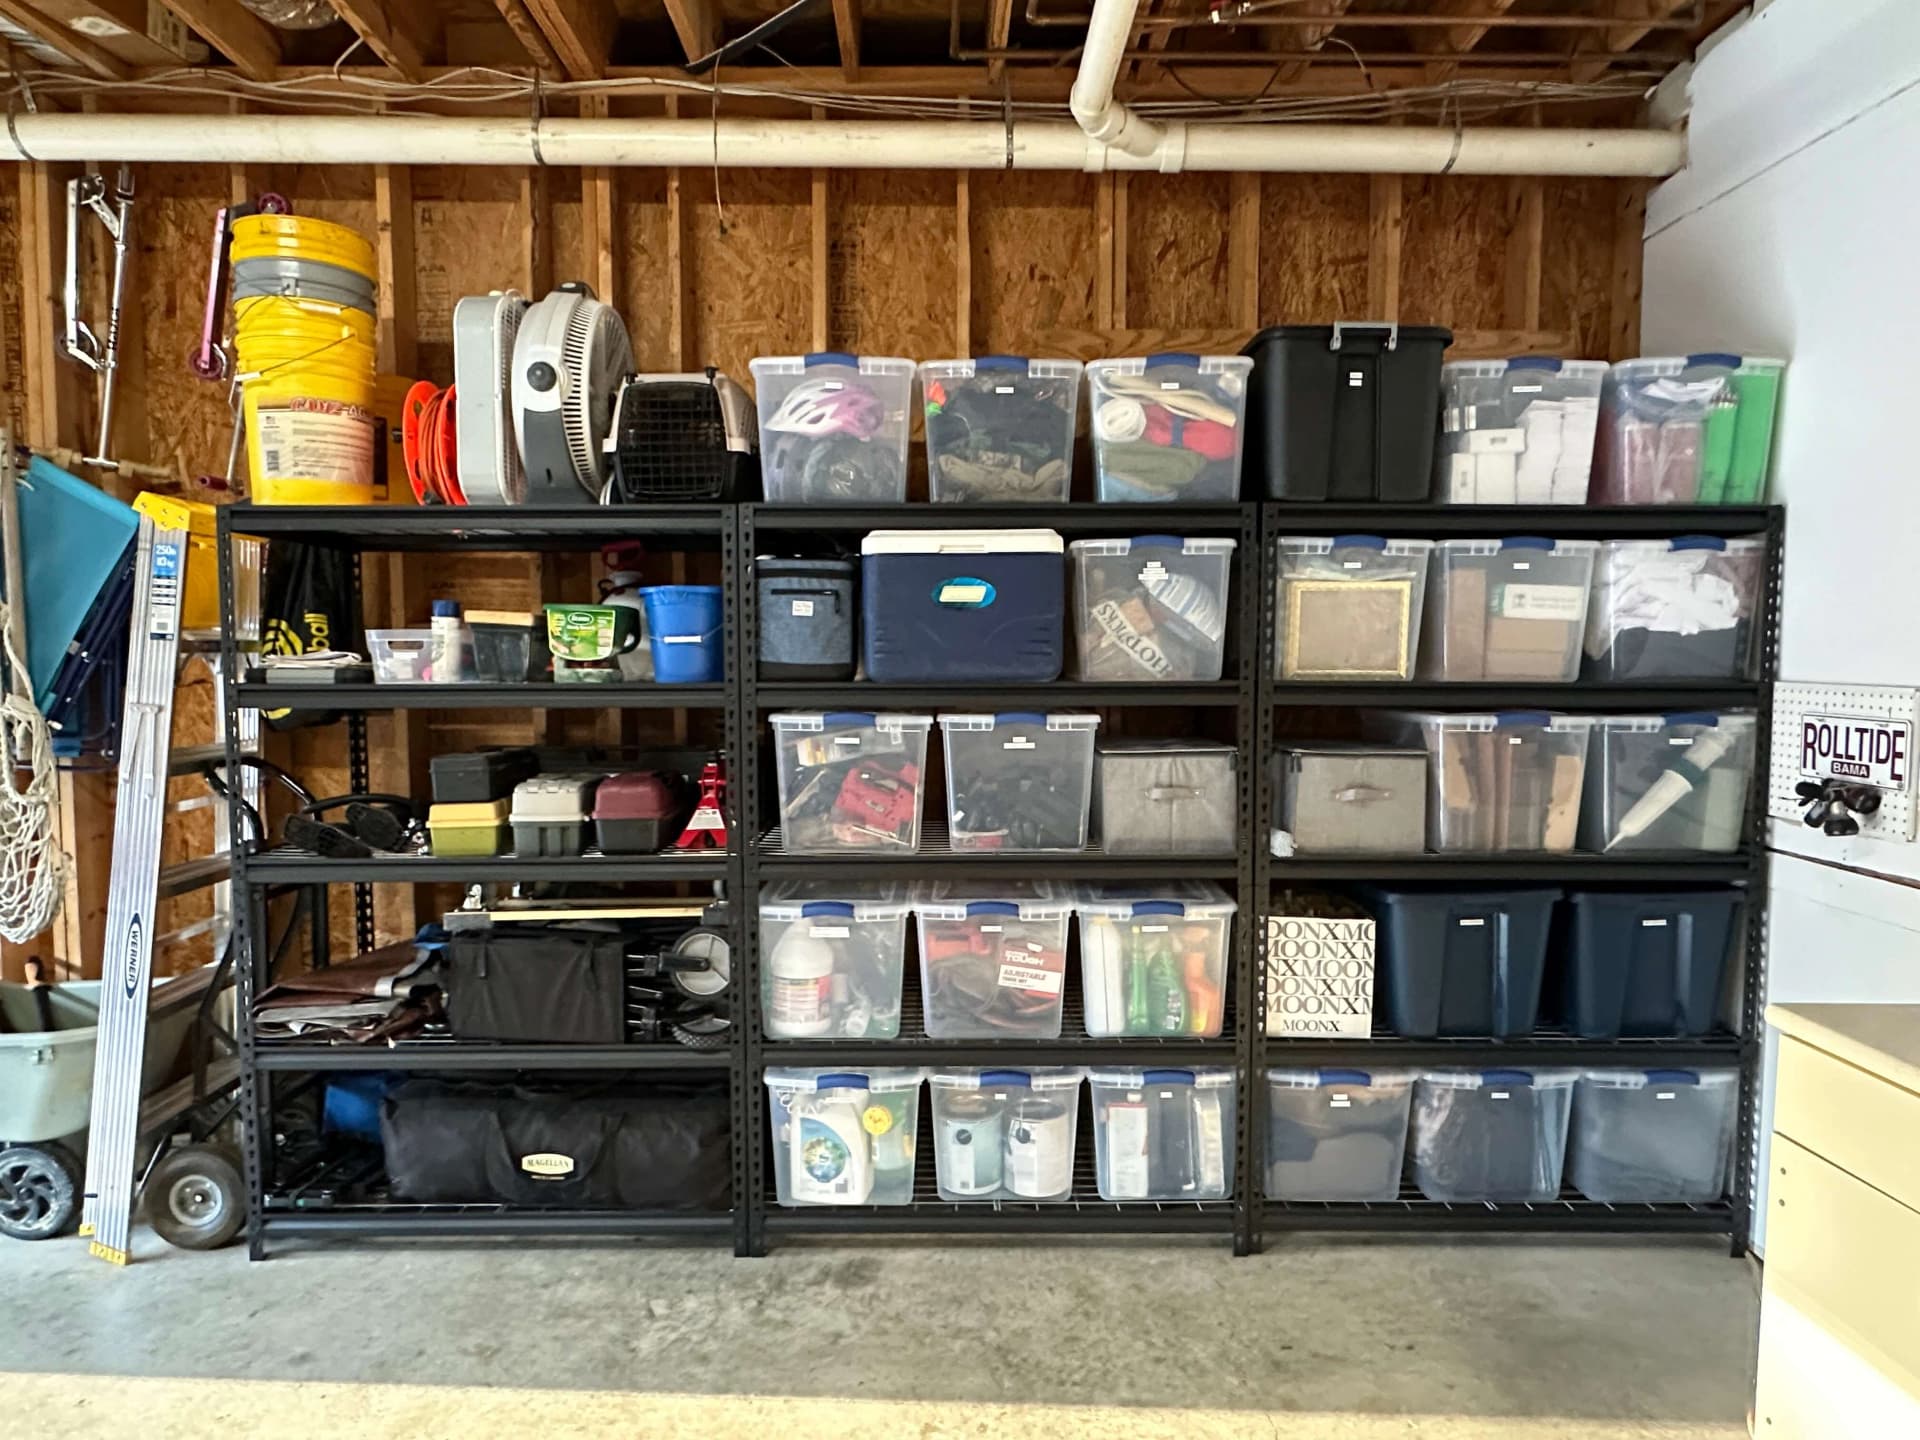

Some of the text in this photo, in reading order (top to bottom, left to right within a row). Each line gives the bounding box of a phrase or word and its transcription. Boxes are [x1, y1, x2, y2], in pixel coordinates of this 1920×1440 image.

[1832, 762, 1868, 777] BAMA
[128, 930, 138, 982] WERNER
[1282, 1019, 1343, 1032] MOONX
[527, 1159, 569, 1167] MAGELLAN
